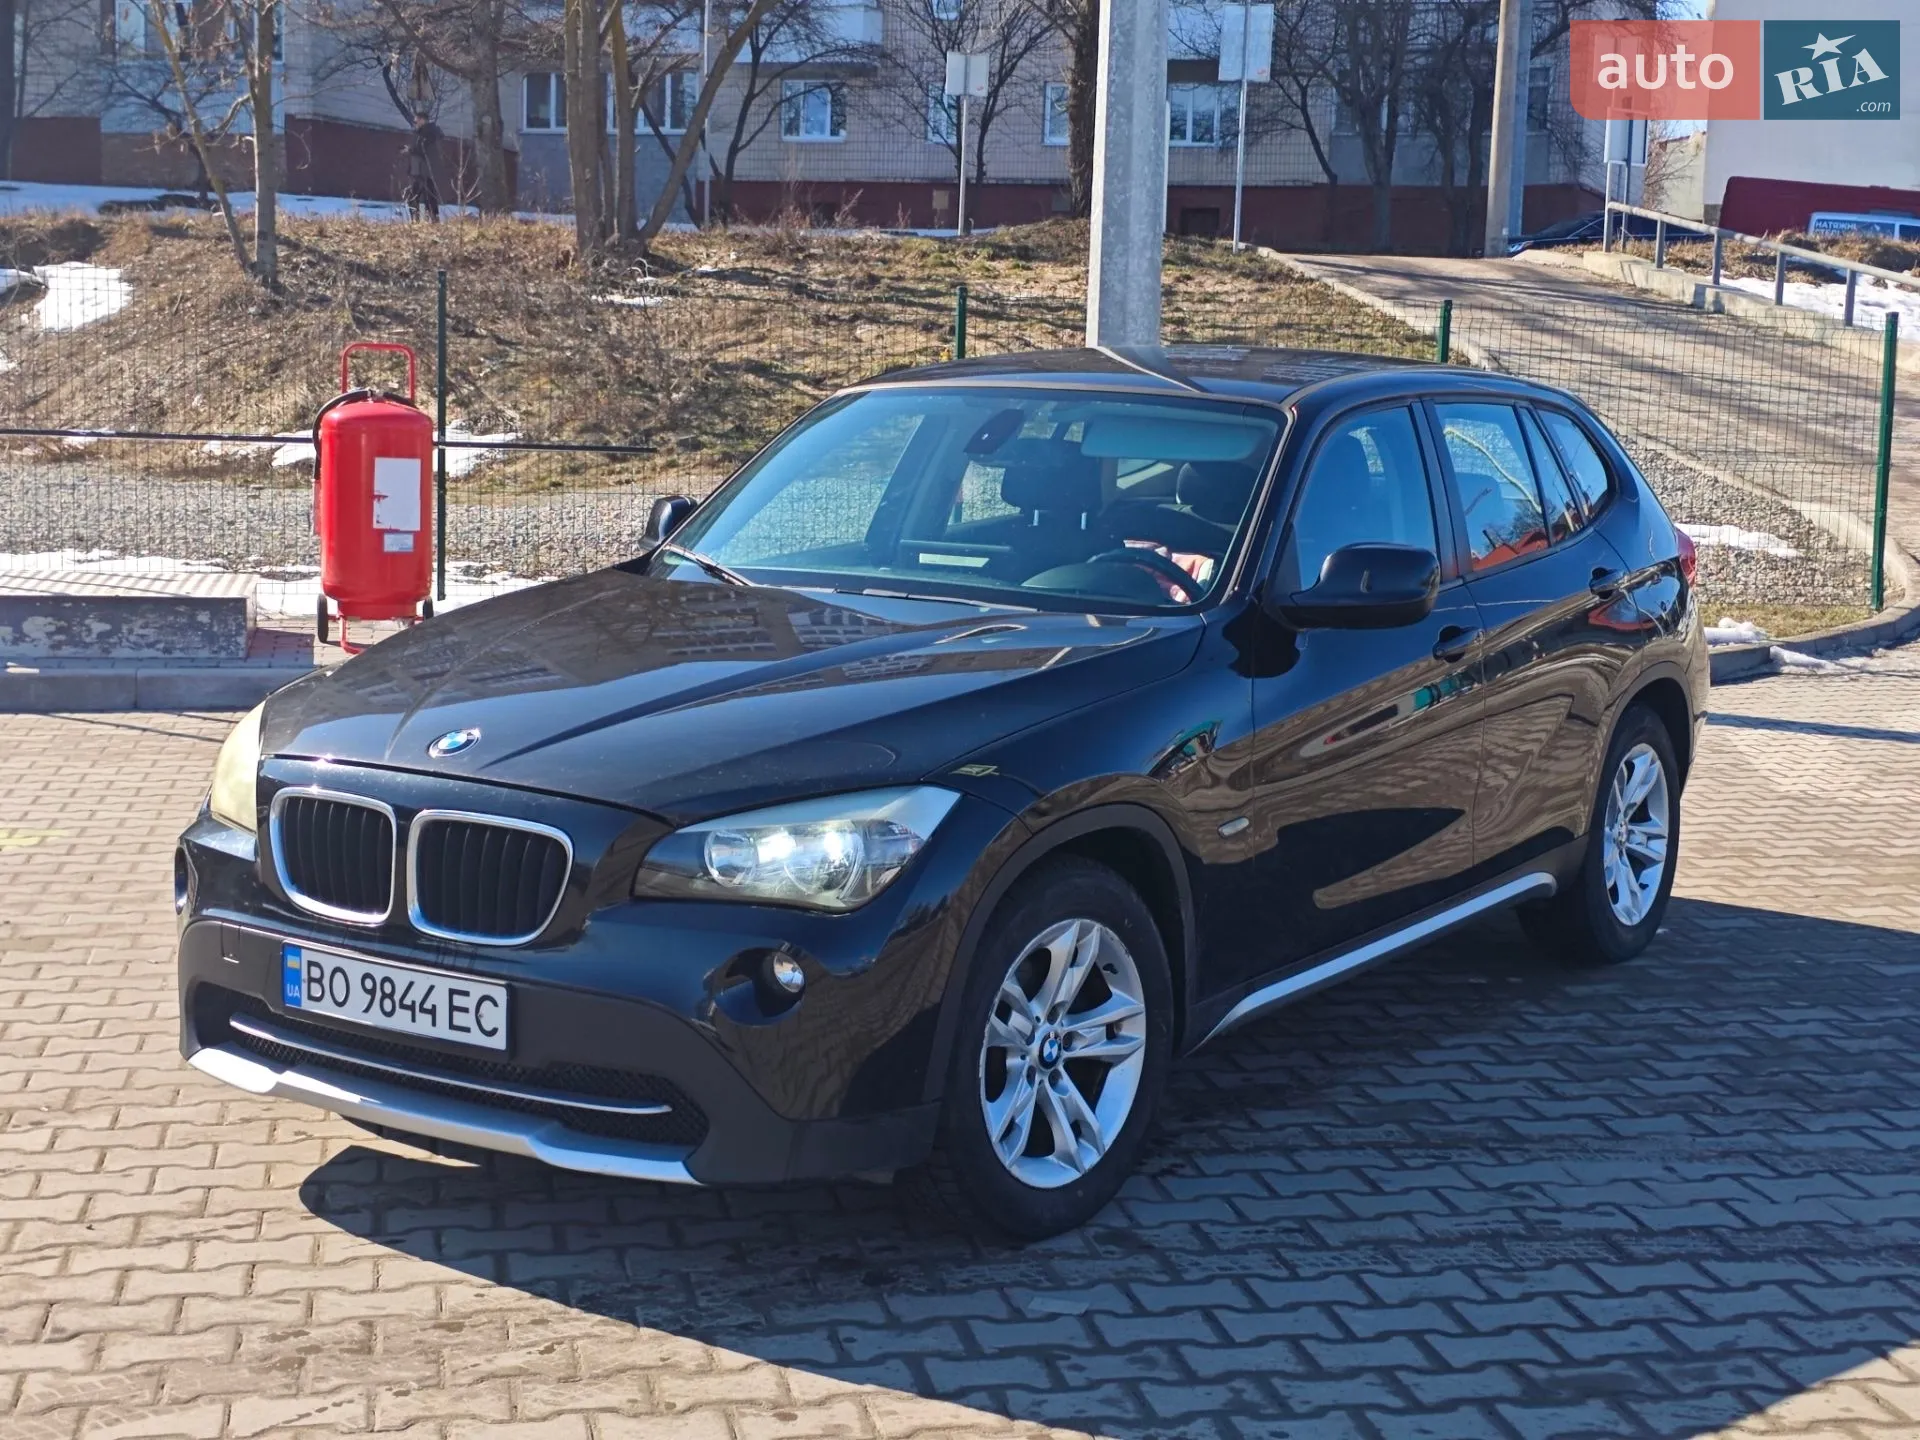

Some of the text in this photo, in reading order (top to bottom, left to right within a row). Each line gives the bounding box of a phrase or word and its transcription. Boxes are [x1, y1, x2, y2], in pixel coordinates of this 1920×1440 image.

[287, 984, 300, 998] UA
[307, 960, 499, 1037] BO 9844 EC
